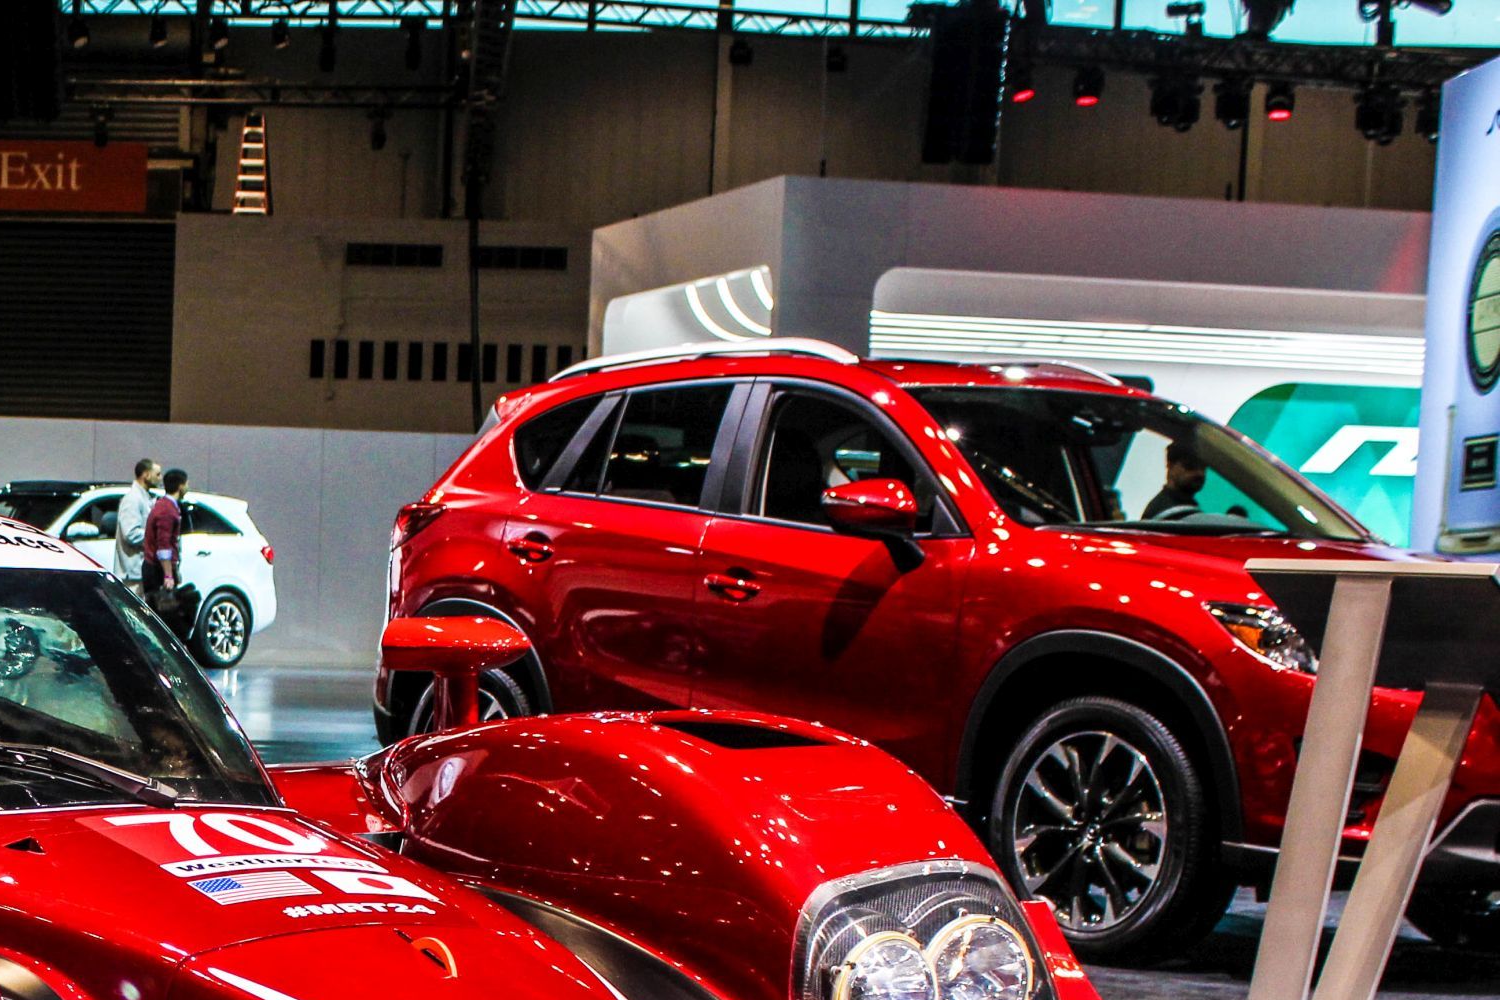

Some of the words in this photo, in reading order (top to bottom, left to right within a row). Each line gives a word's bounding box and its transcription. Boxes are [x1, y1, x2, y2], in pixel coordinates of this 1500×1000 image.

[102, 813, 327, 856] 70
[176, 856, 376, 872] WeatherTech
[282, 902, 437, 919] #MRT24
